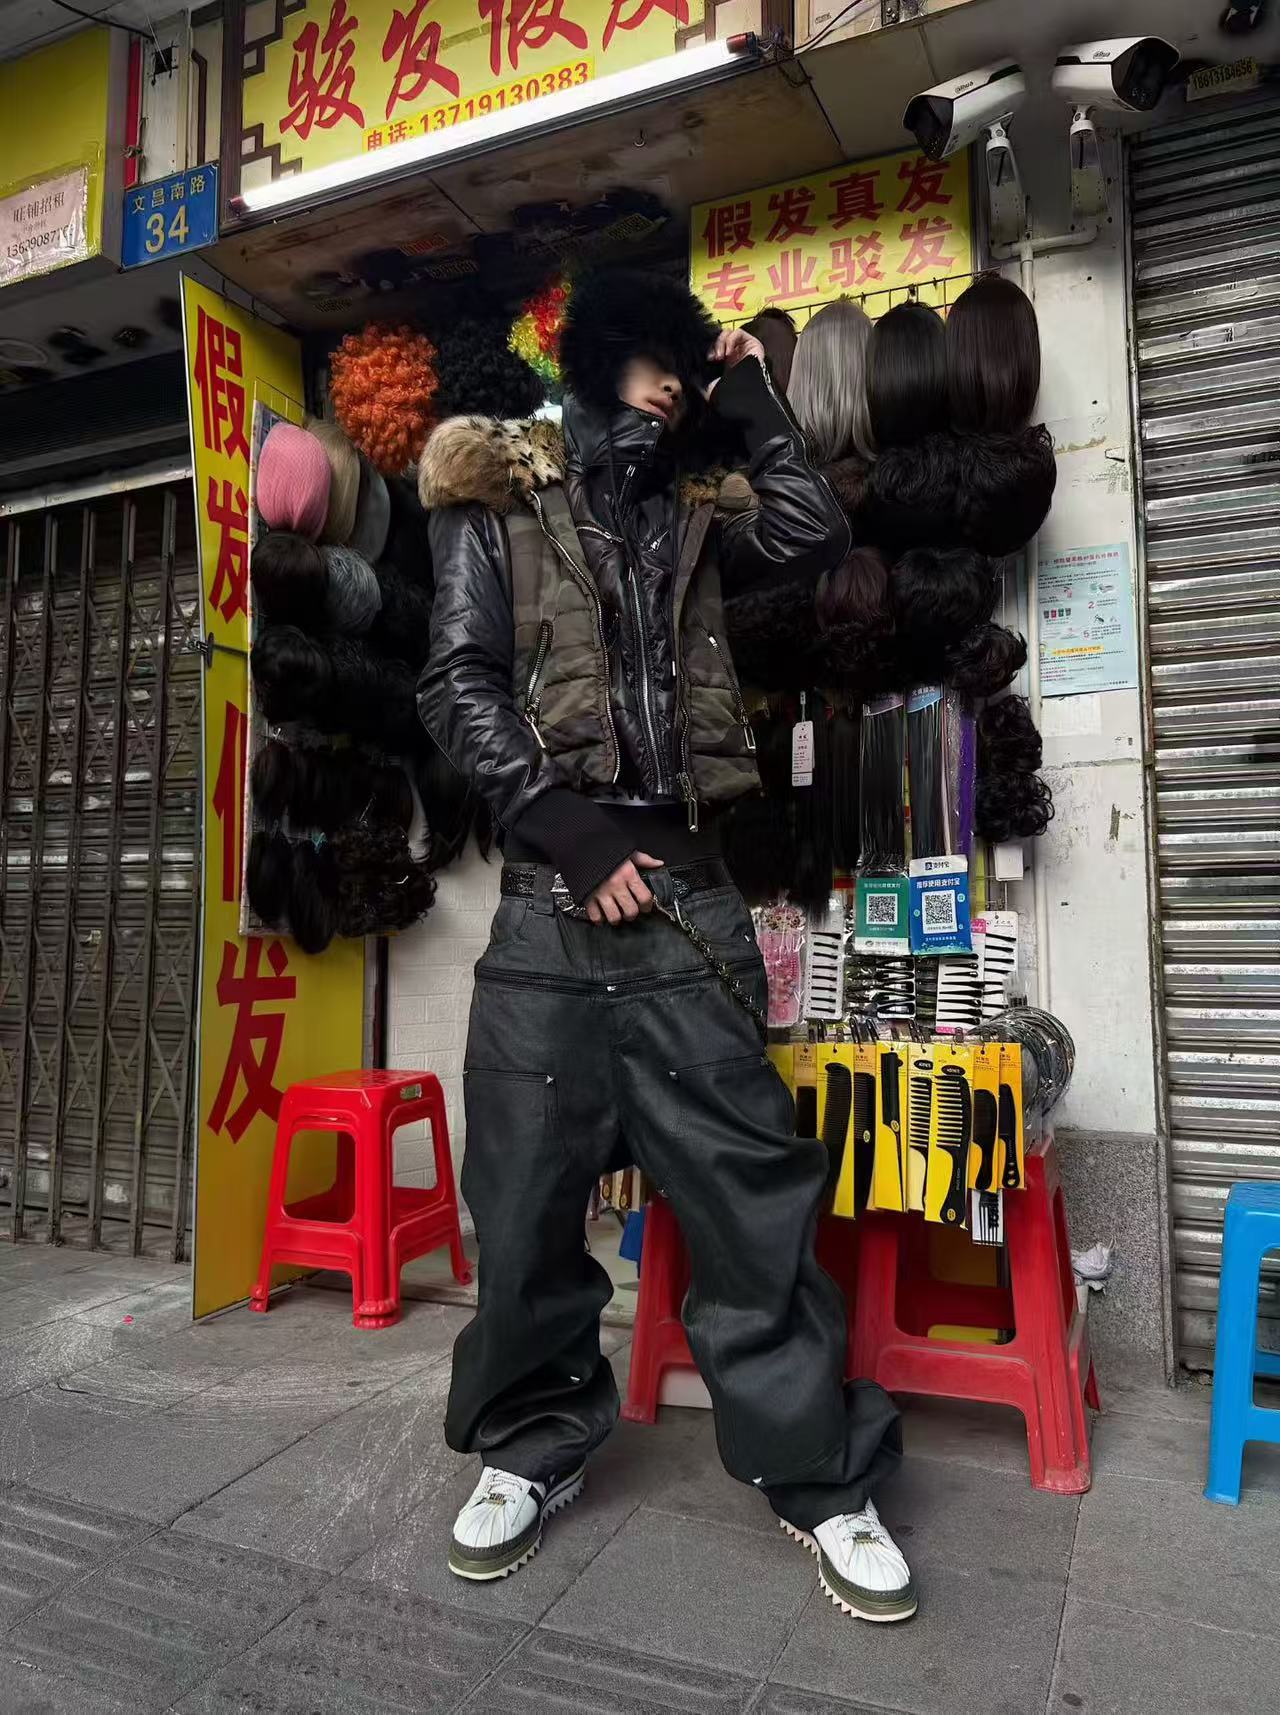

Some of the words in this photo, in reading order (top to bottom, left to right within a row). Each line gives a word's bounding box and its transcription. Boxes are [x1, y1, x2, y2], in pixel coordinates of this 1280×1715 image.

[132, 174, 206, 215] 文昌南路
[145, 204, 190, 254] 34
[702, 154, 953, 259] 假发真发
[702, 215, 955, 312] 专业驳发
